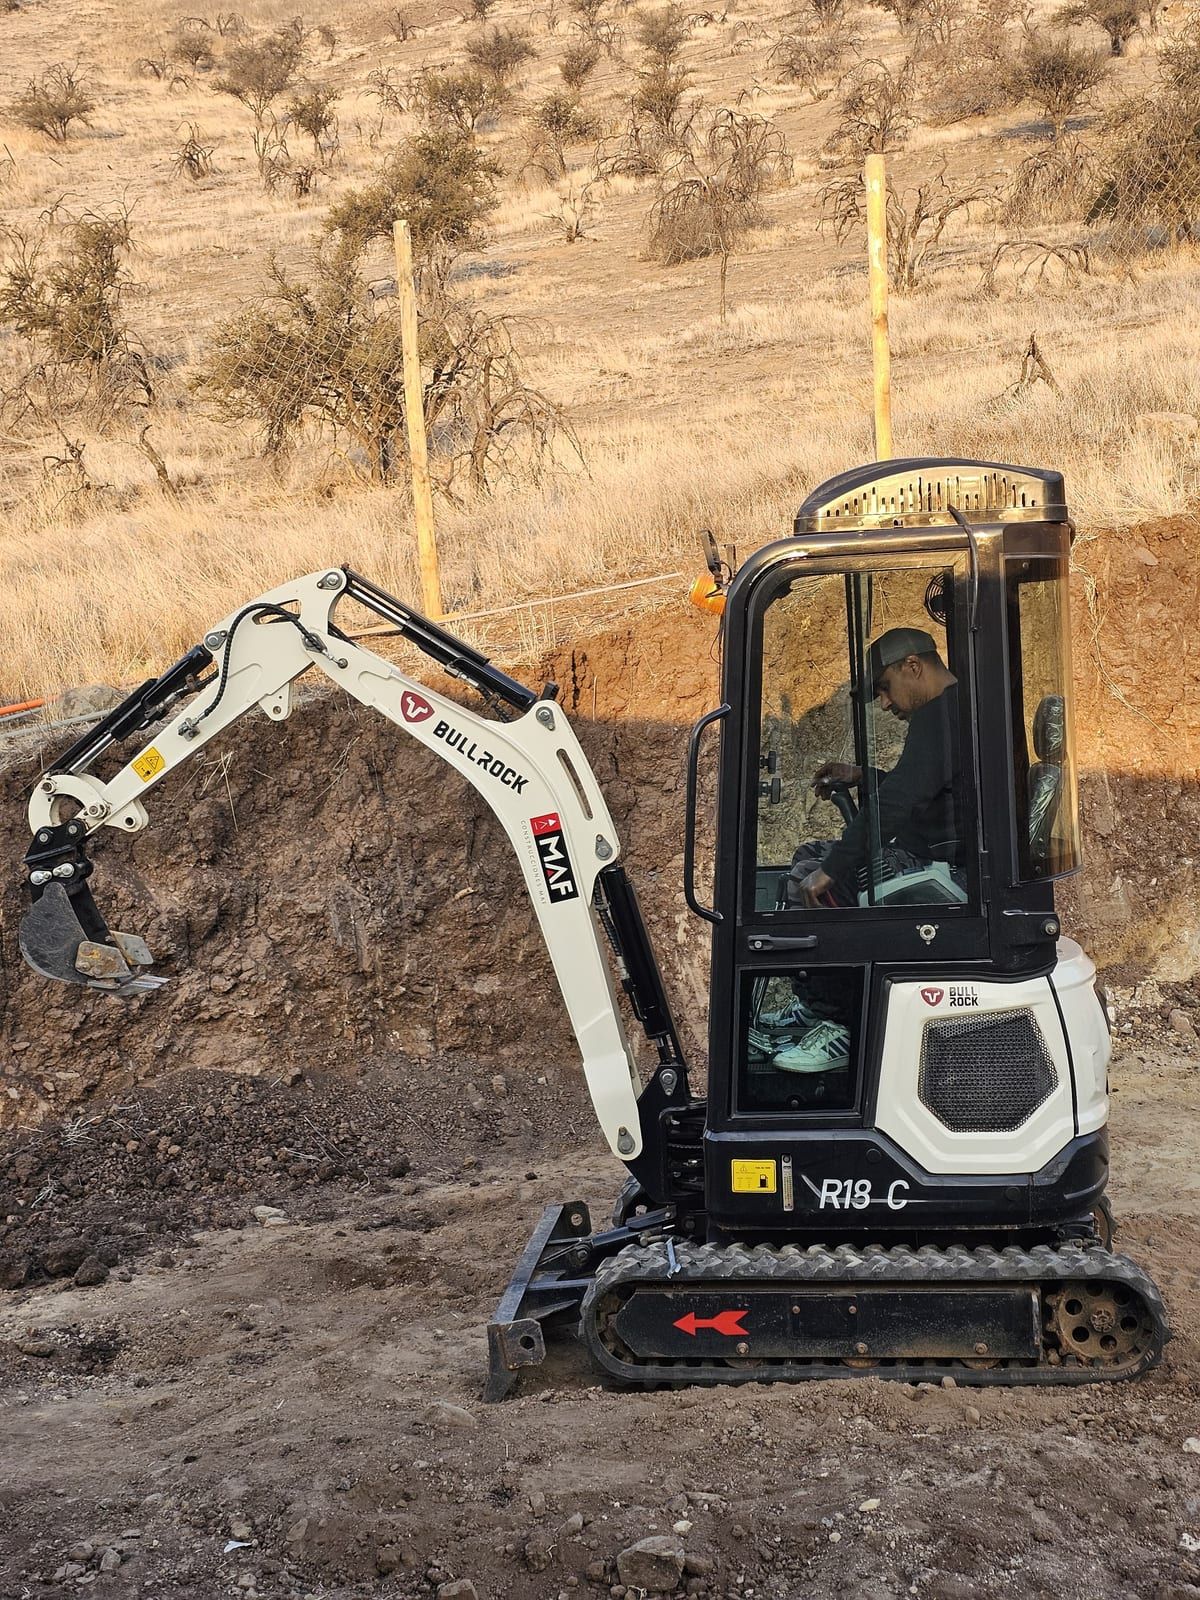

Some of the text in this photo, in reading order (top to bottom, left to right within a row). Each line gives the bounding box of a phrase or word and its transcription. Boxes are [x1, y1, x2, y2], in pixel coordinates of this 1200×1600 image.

[432, 720, 530, 795] BULLROCK
[538, 835, 574, 896] MAF
[949, 986, 978, 997] BULL
[949, 996, 979, 1007] ROCK
[819, 1178, 872, 1210] R18
[887, 1179, 910, 1210] C
